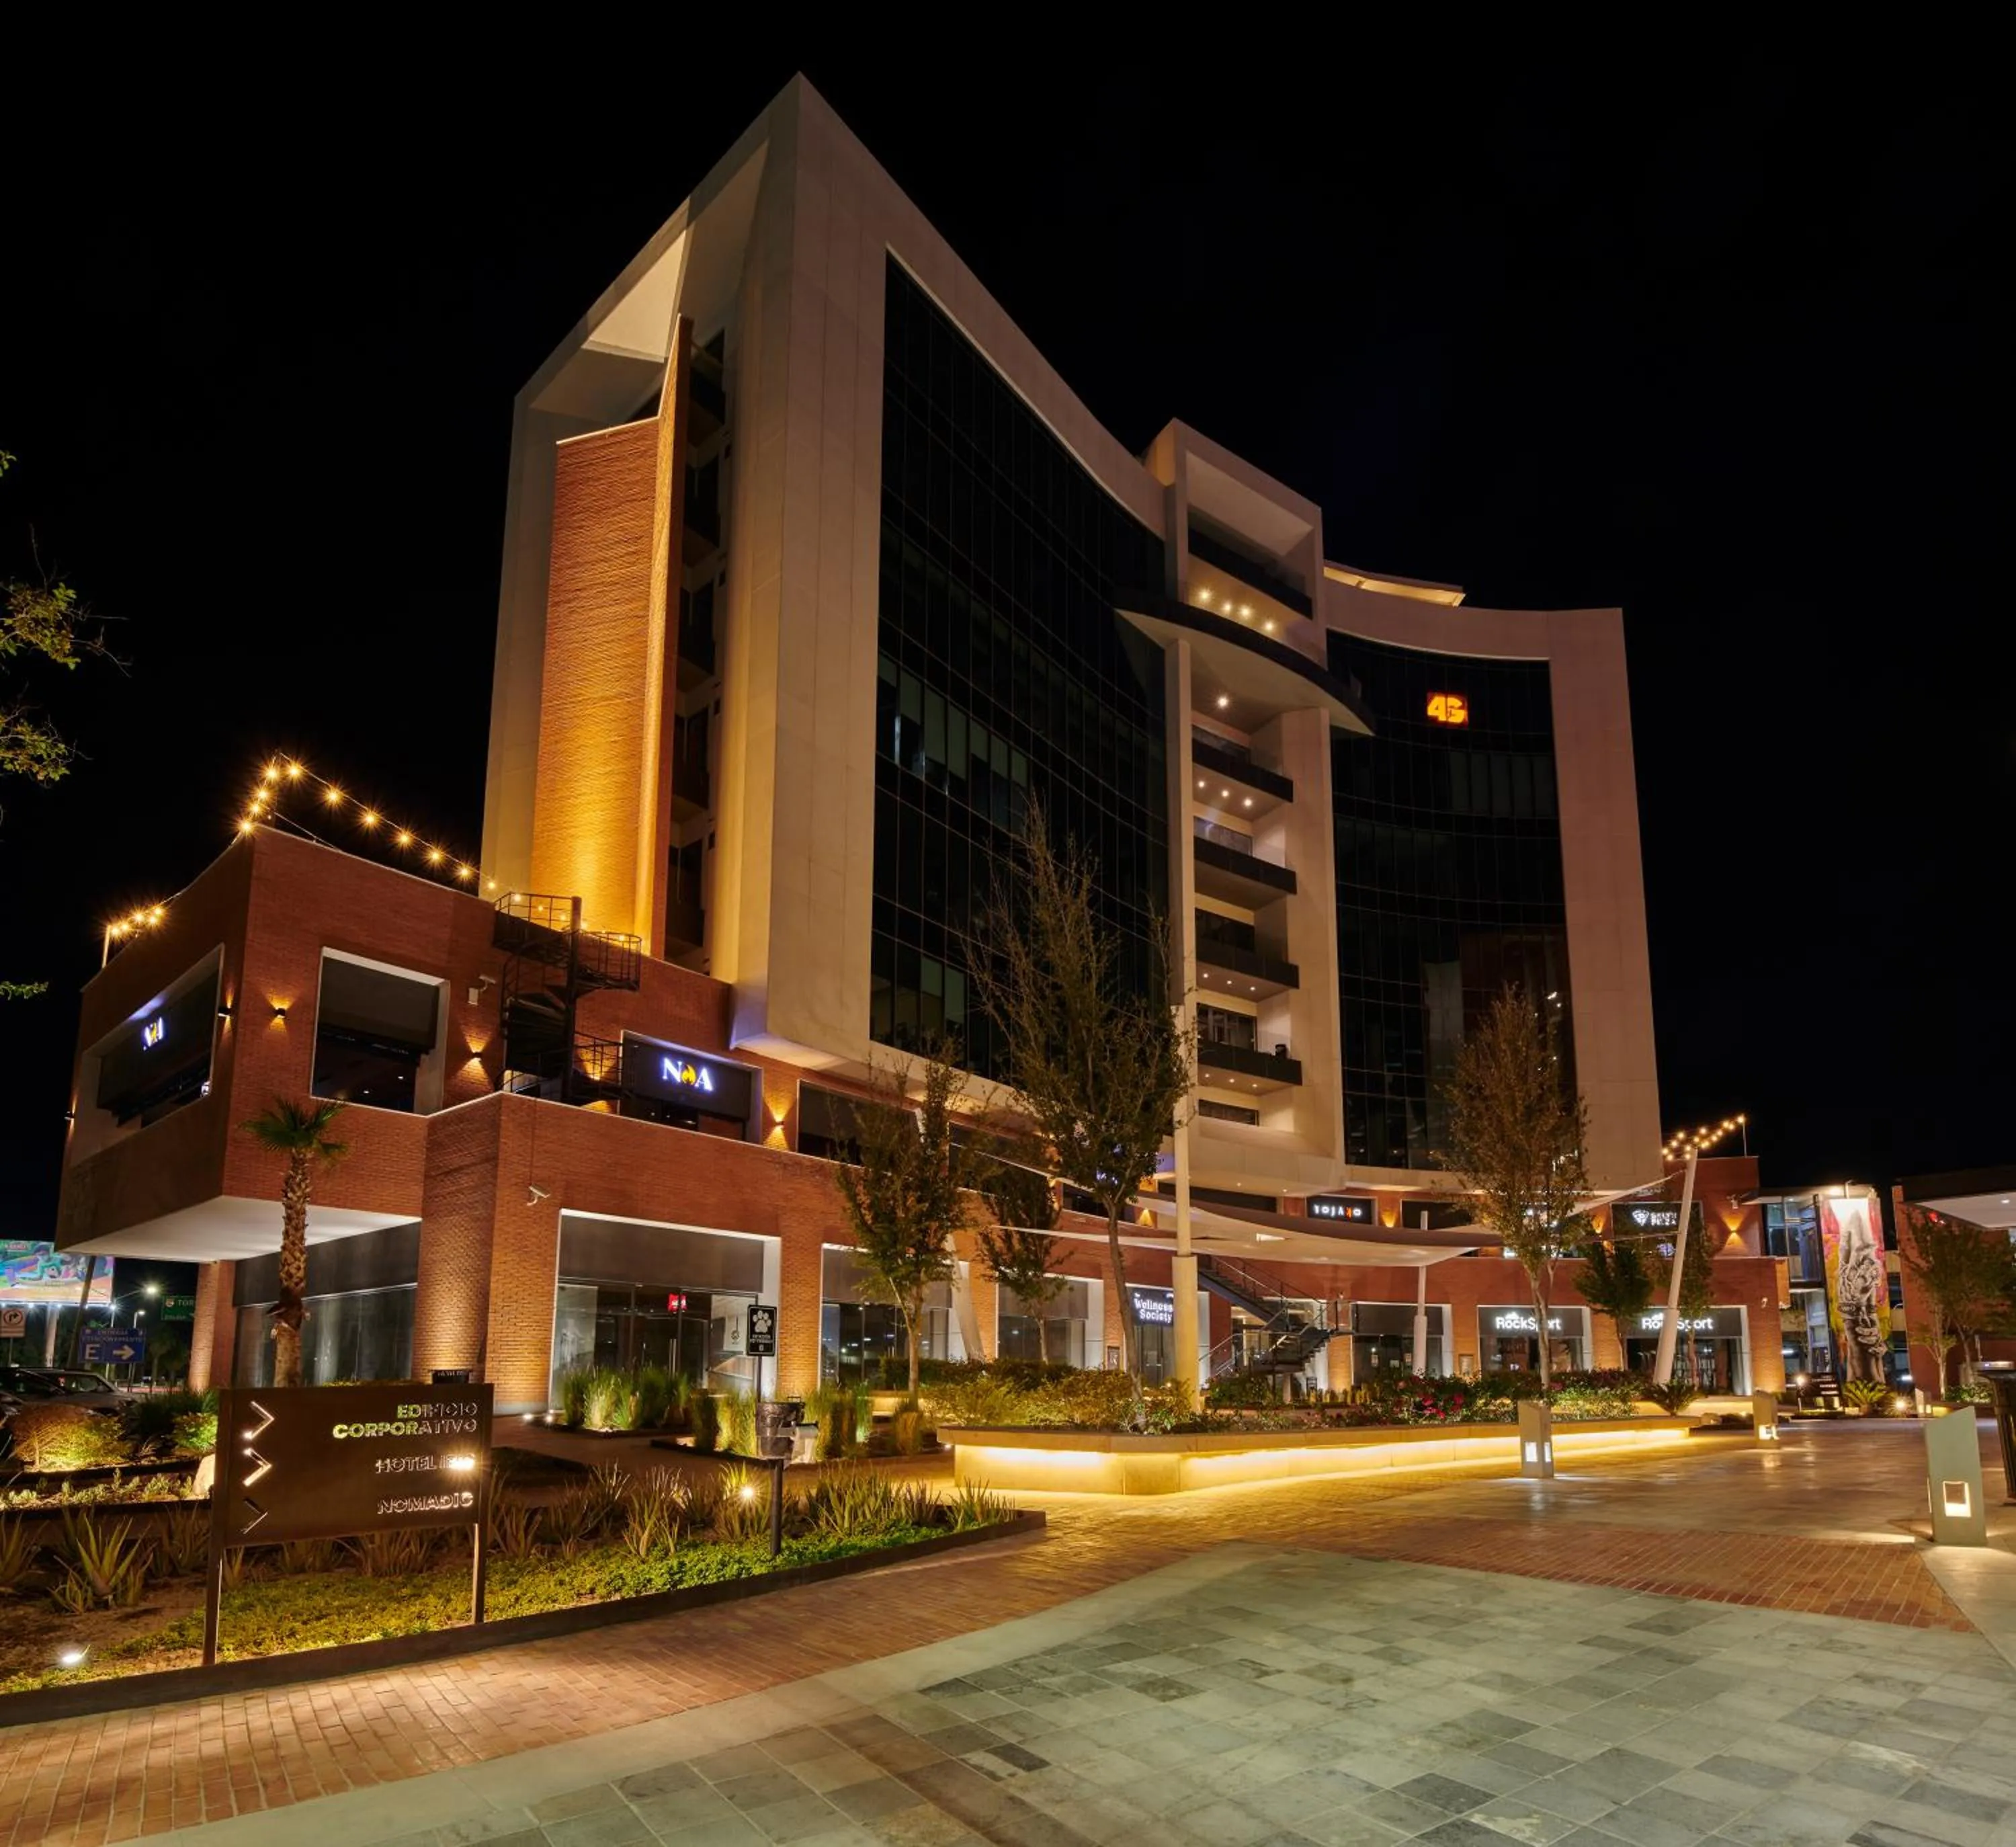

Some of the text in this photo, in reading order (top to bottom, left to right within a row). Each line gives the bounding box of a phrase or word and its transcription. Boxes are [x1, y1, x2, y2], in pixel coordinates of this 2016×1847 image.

[1134, 1298, 1173, 1313] Wellness
[1139, 1309, 1173, 1323] Society
[1496, 1316, 1562, 1332] RockSrt
[1642, 1317, 1714, 1332] RoSport
[397, 1402, 478, 1419] EDIFICIO
[333, 1419, 478, 1439] CORPORATIVO
[376, 1454, 438, 1474] HOTEL
[377, 1491, 474, 1514] NOMADIC
